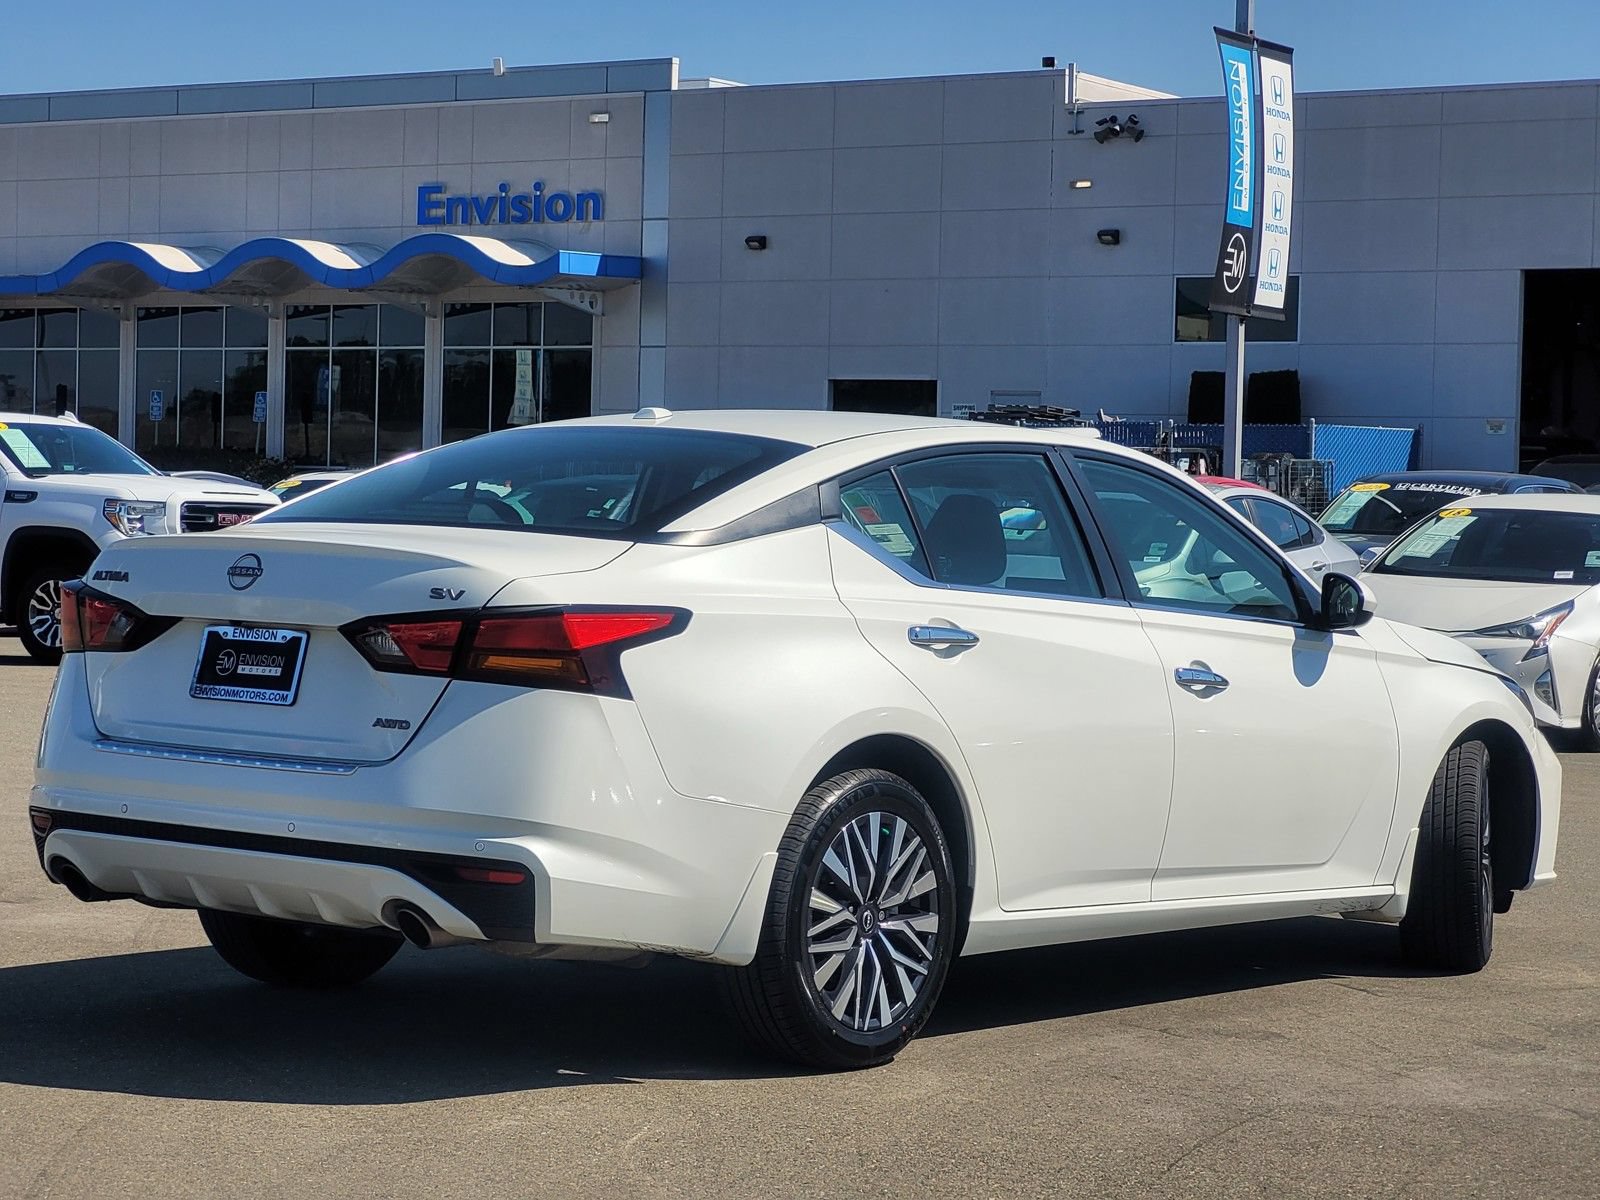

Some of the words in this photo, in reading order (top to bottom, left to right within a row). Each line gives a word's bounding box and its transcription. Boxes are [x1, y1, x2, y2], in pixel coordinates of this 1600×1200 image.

[1266, 107, 1291, 122] HONDA
[1228, 59, 1246, 210] ENVISION
[1267, 165, 1291, 179] HONDA
[417, 181, 604, 226] Envision
[1265, 222, 1288, 236] HONDA
[1259, 280, 1283, 293] HONDA
[1410, 482, 1482, 494] CERTIFIED
[228, 567, 262, 577] NISSAN
[429, 587, 466, 601] SV
[232, 628, 278, 641] ENVISION
[238, 653, 285, 667] ENVISION
[241, 667, 280, 675] MOTORS
[194, 685, 290, 703] ENVISIONMOTORS.COM
[372, 717, 411, 730] AWD
